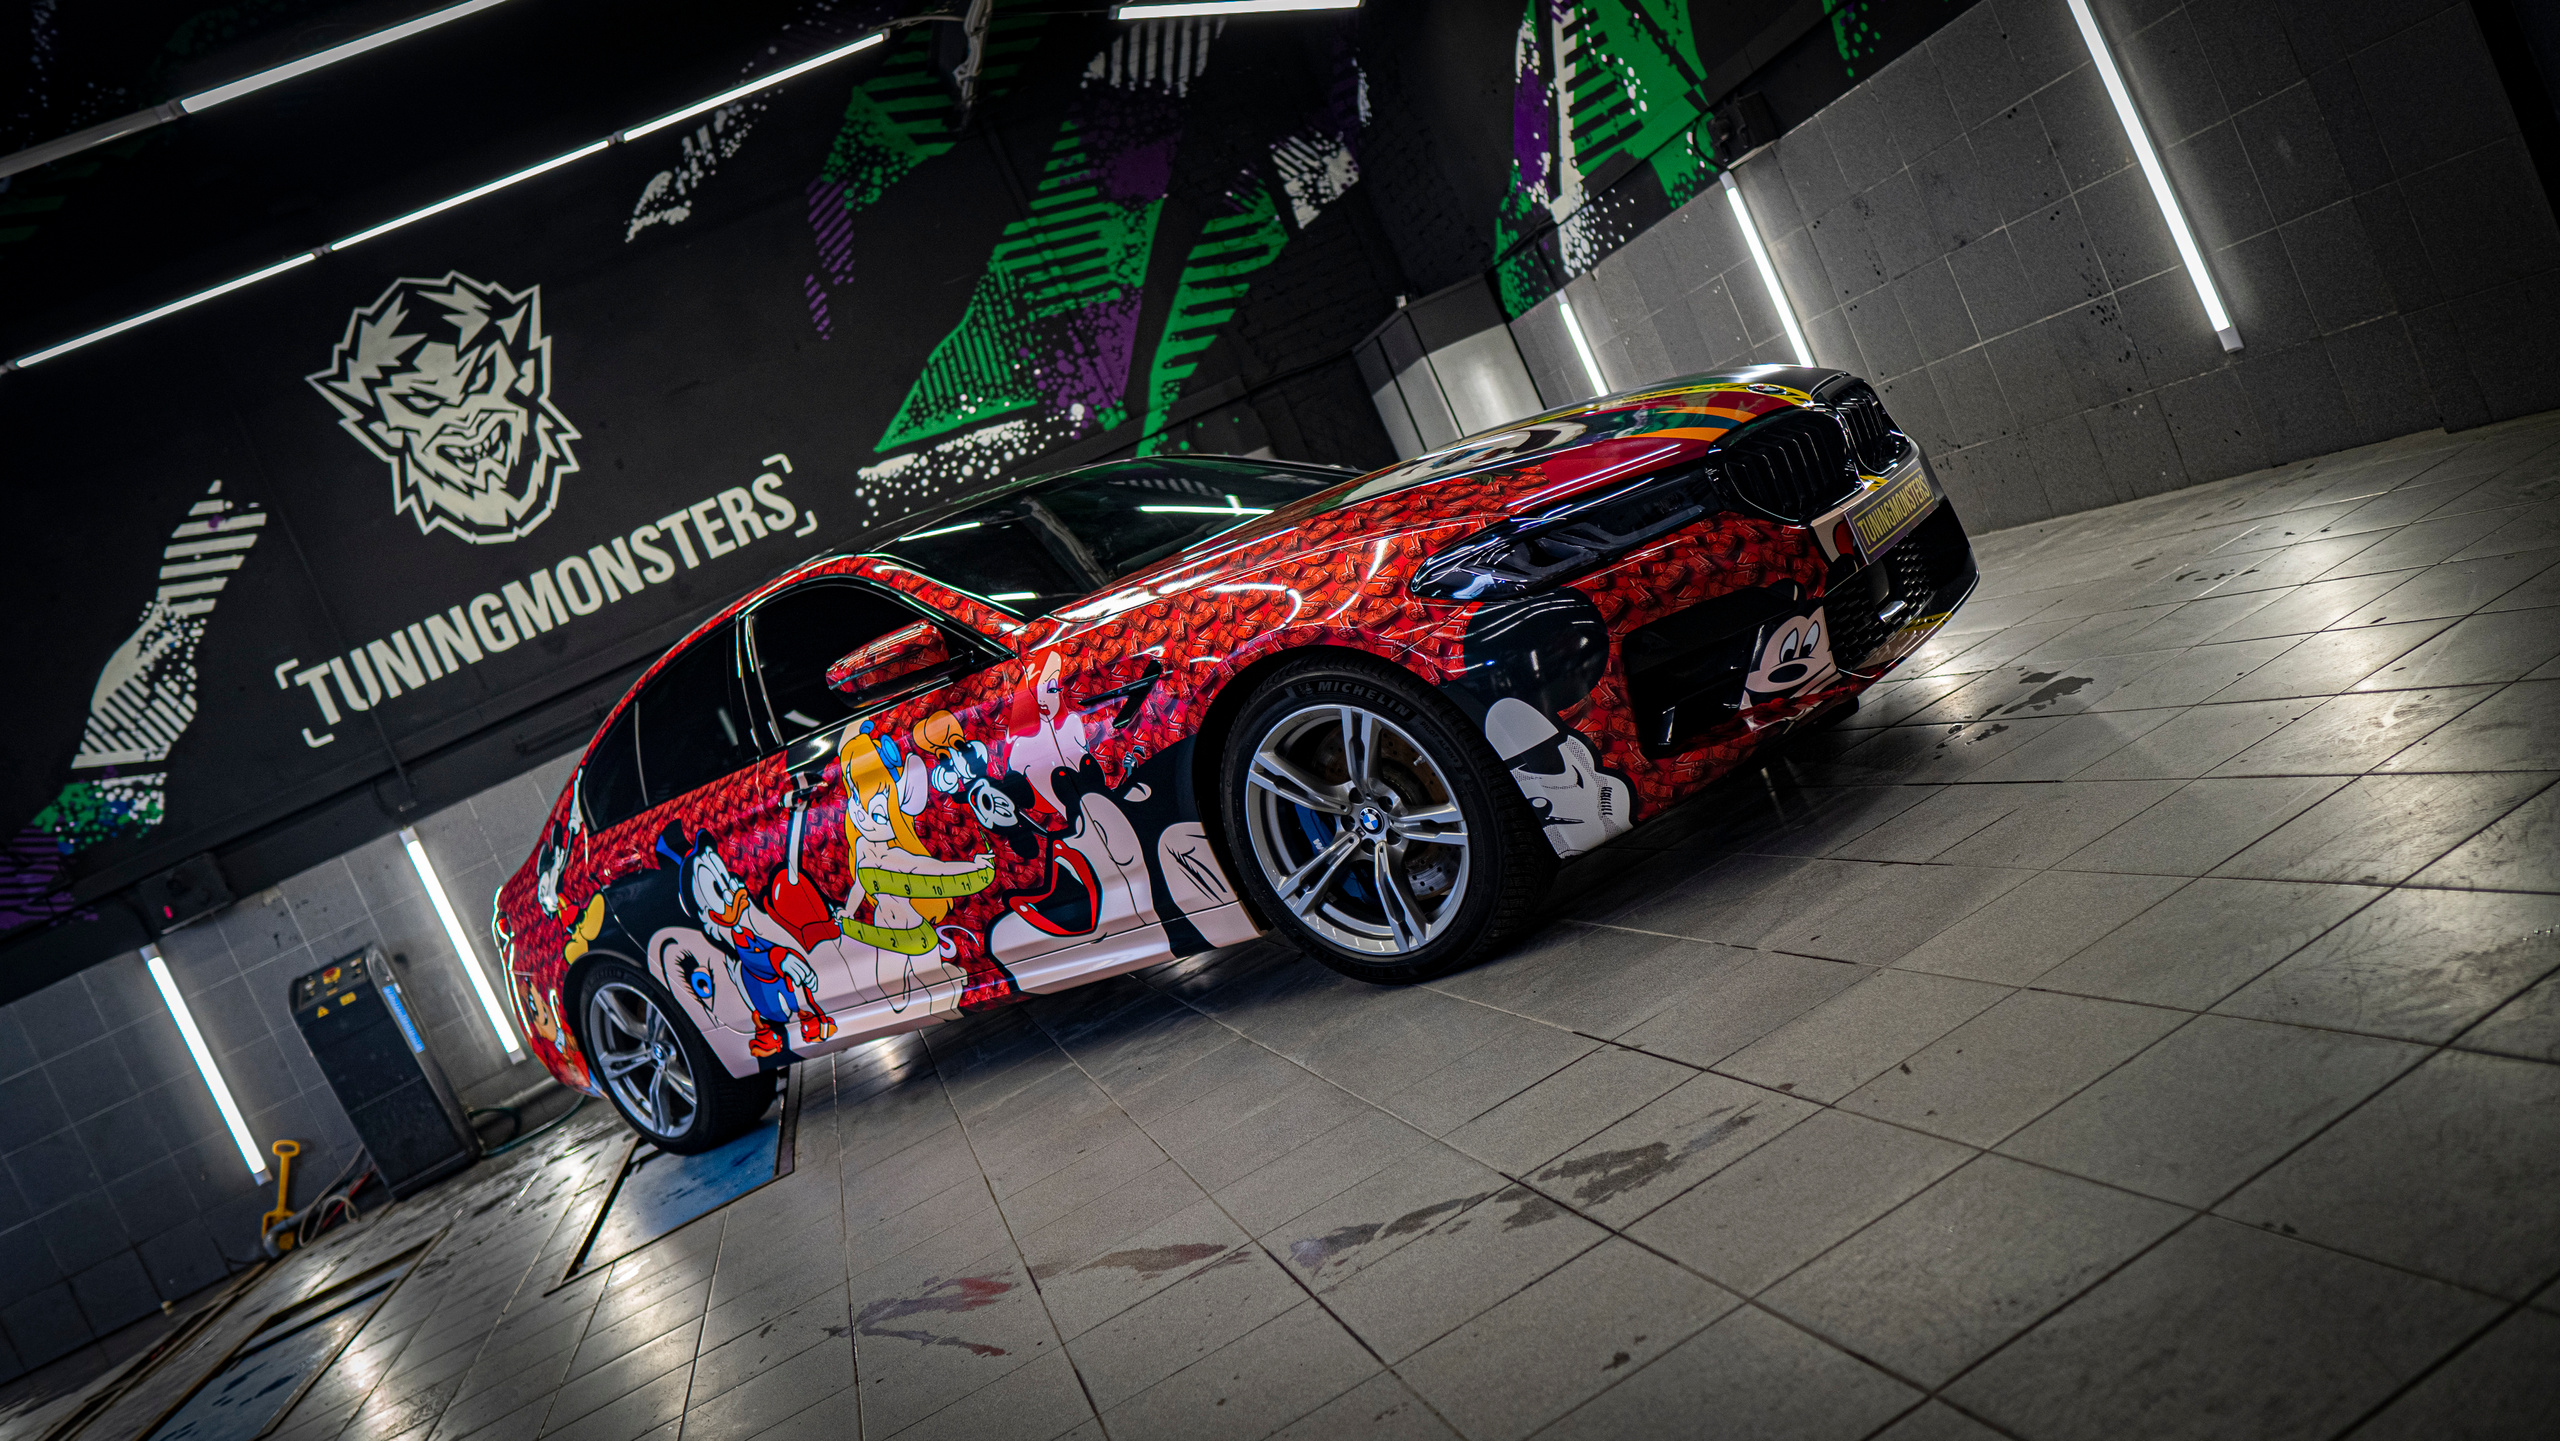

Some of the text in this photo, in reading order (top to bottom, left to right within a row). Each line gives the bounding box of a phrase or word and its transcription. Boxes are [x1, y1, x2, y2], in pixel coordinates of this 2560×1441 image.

[1856, 474, 1931, 546] TUNINGMONSTERS
[294, 472, 798, 725] TUNINGMONSTERS
[1317, 681, 1410, 717] MICHELIN
[1420, 721, 1439, 738] PILOT
[872, 880, 880, 892] 8
[904, 884, 911, 896] 9
[932, 885, 943, 896] 10
[961, 881, 972, 892] 11
[858, 930, 928, 949] 1 2 3
